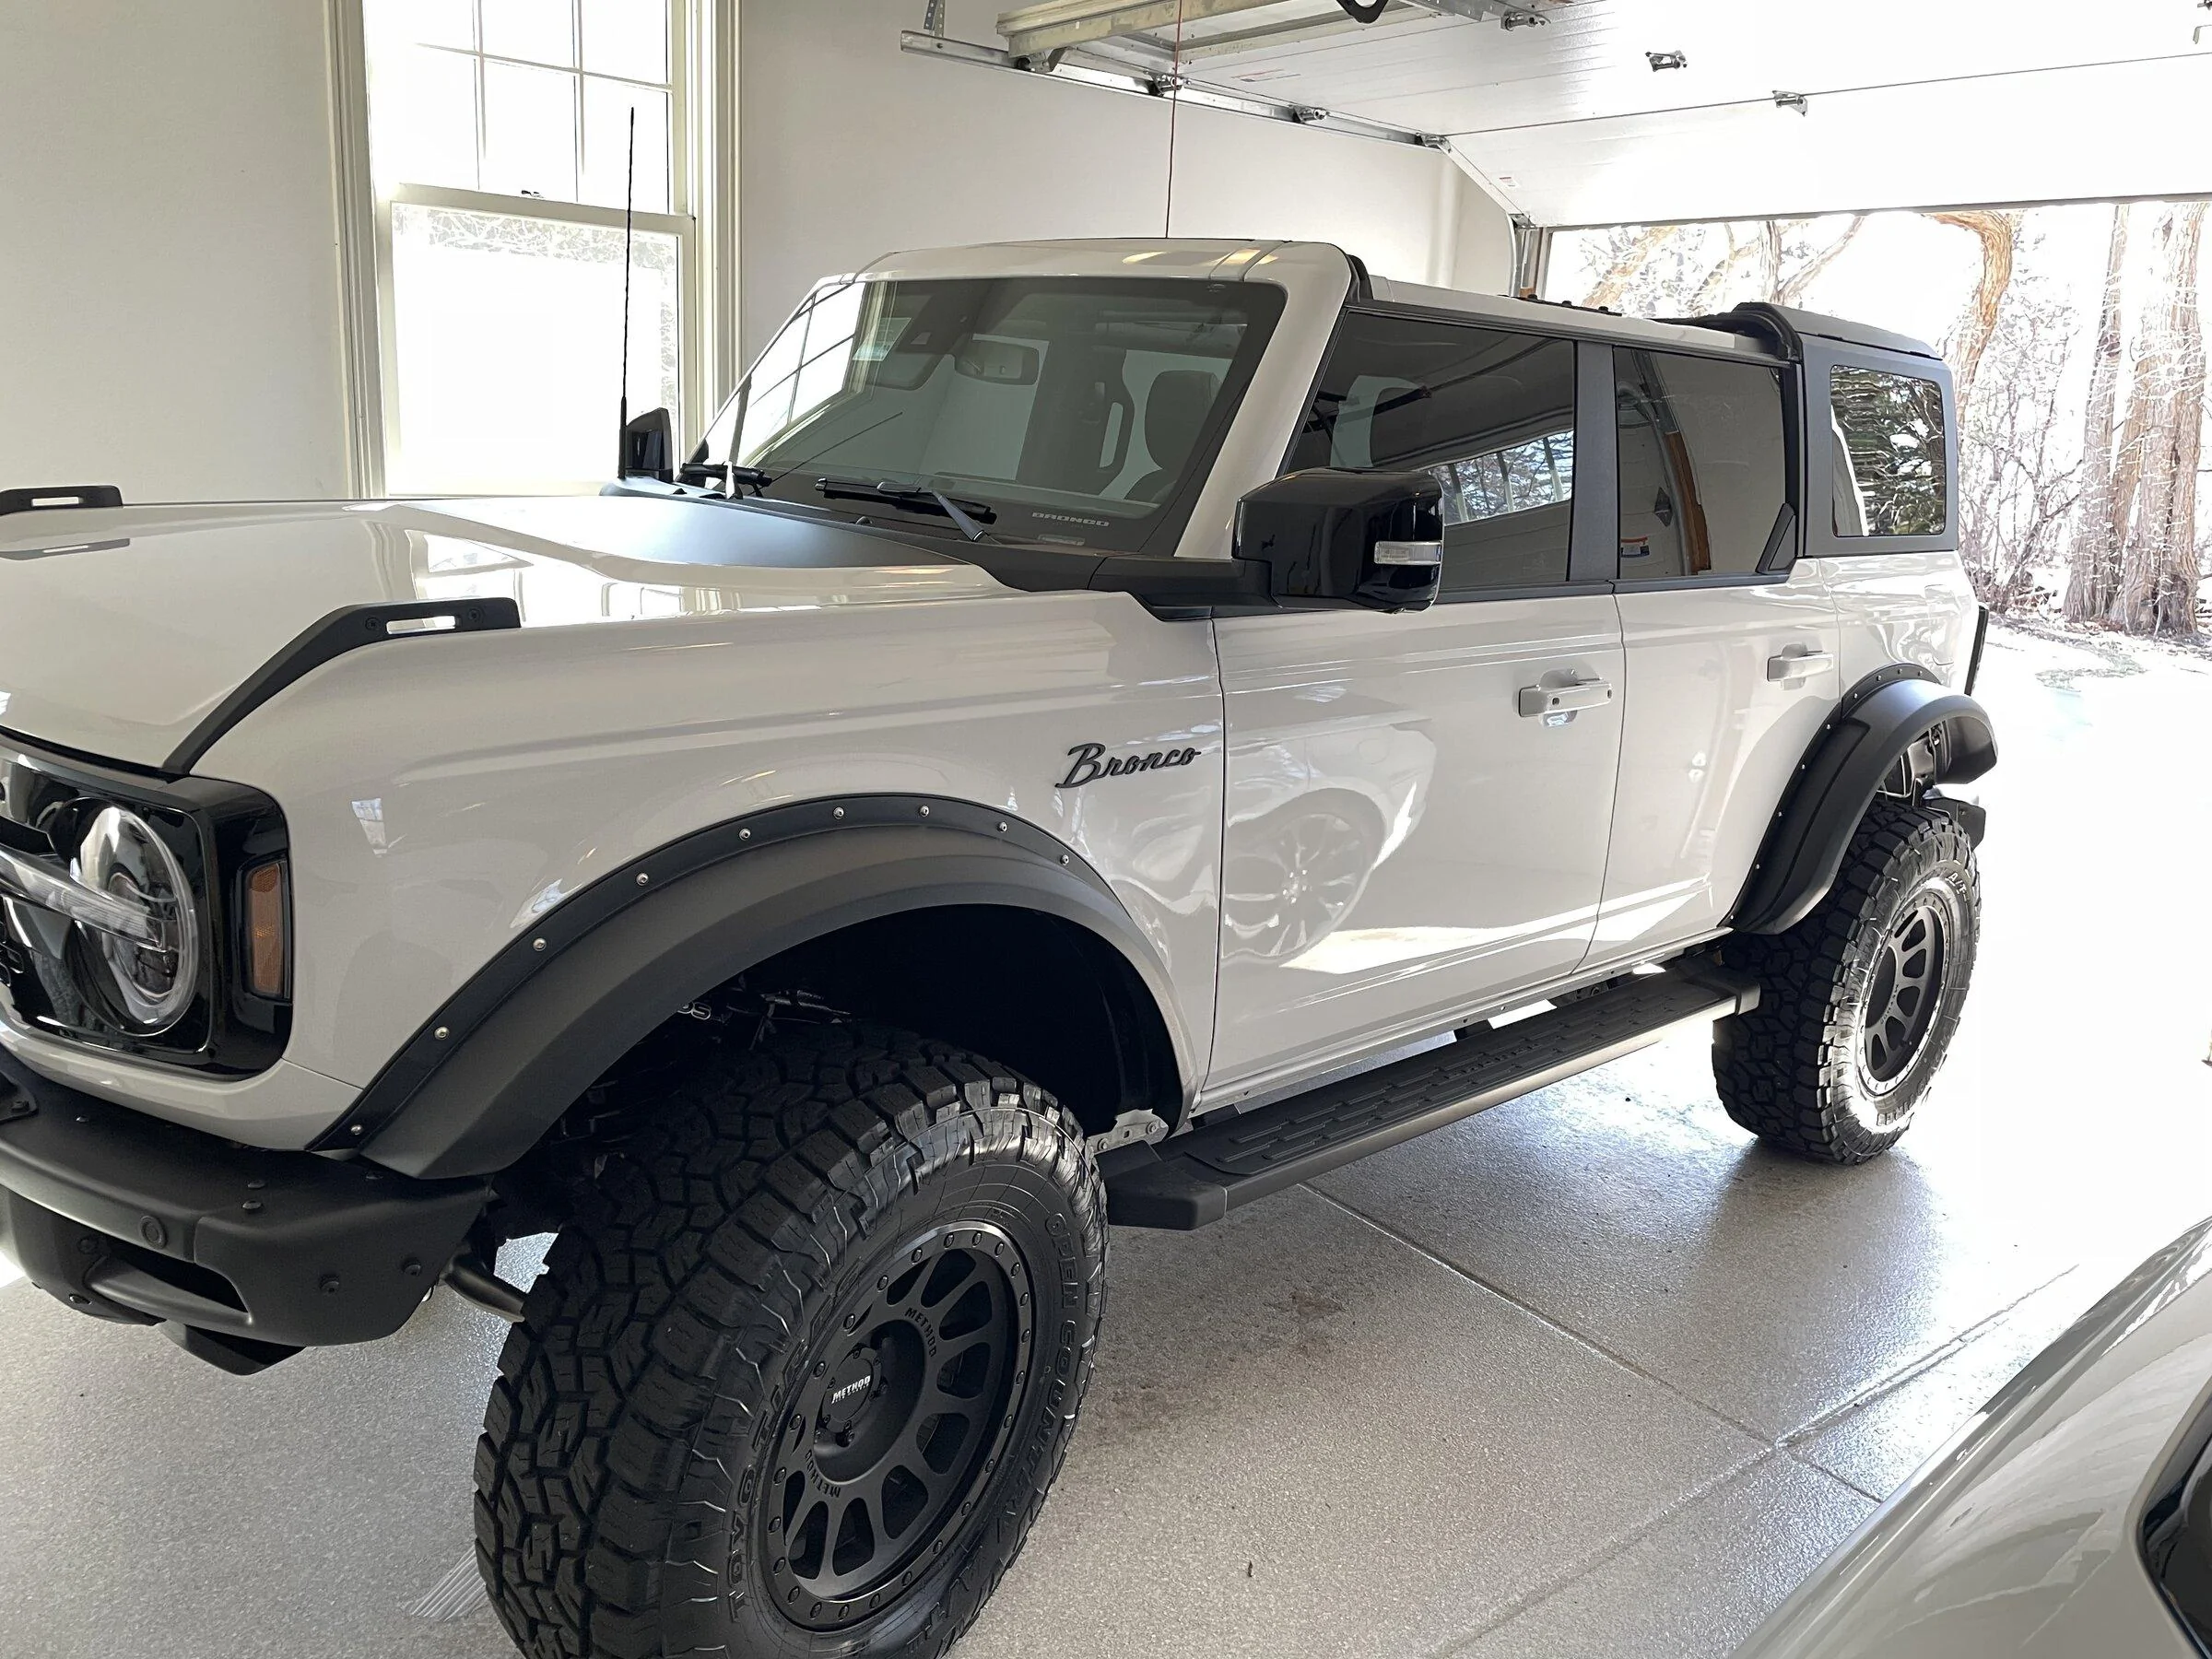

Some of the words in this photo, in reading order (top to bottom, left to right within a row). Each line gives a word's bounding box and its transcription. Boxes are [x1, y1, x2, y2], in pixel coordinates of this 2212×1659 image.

[1032, 512, 1110, 527] BRONCO
[1054, 742, 1202, 789] Bronco
[1044, 1212, 1078, 1309] OPEN
[904, 1306, 937, 1358] METHOD
[830, 1375, 871, 1406] METHOD
[804, 1448, 841, 1499] METHOD
[726, 1463, 757, 1624] TOYO
